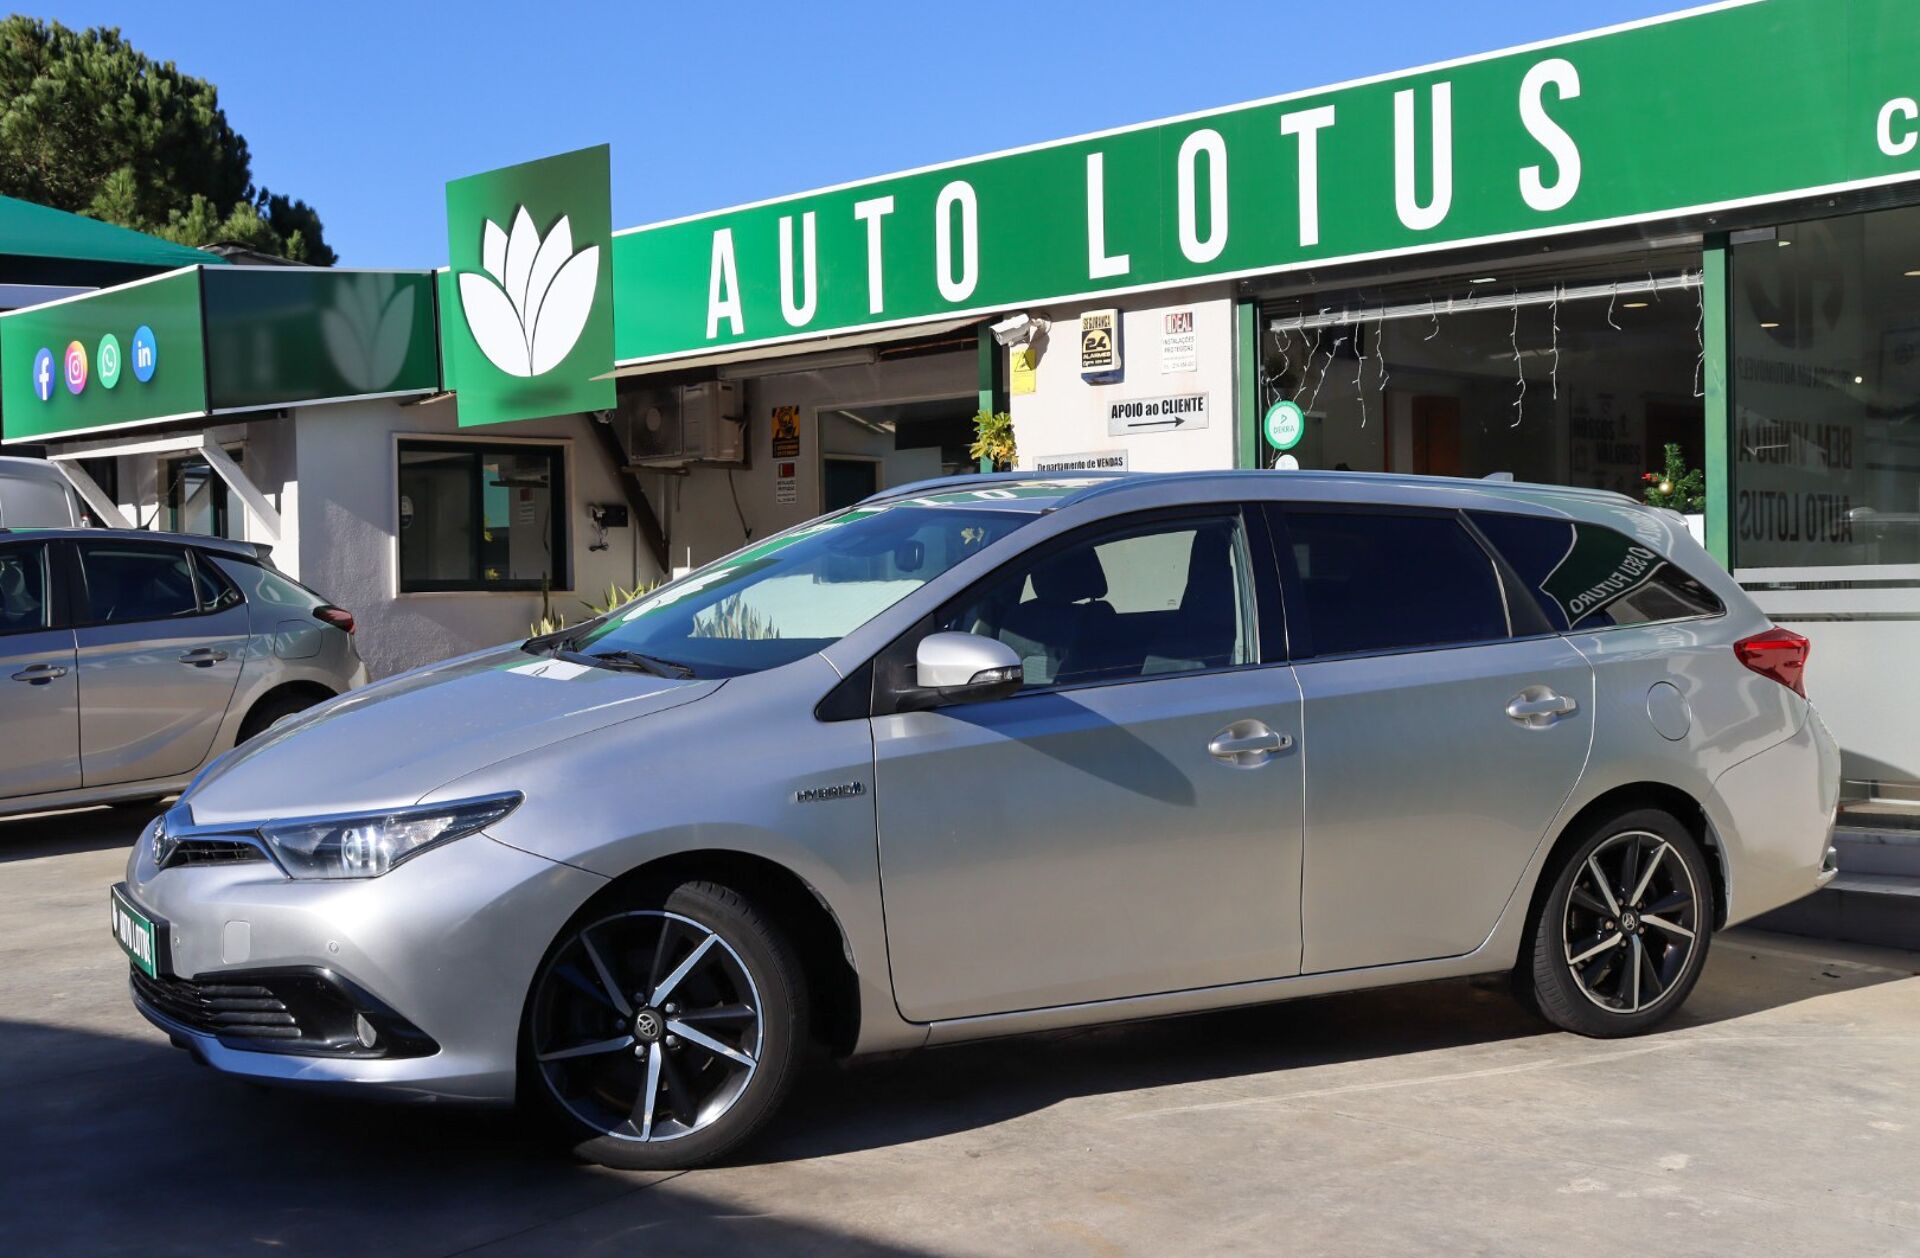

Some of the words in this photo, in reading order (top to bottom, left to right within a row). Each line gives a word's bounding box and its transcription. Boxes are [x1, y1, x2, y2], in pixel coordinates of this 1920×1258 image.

[706, 180, 980, 340] AUTO
[1087, 58, 1582, 280] LOTUS
[1165, 312, 1193, 334] IDEAL
[1085, 335, 1107, 351] 24
[1111, 402, 1143, 419] APOIO
[1145, 403, 1159, 416] ao
[1161, 396, 1204, 415] CLIENTE
[1086, 459, 1096, 469] de
[1096, 456, 1123, 468] VENDAS
